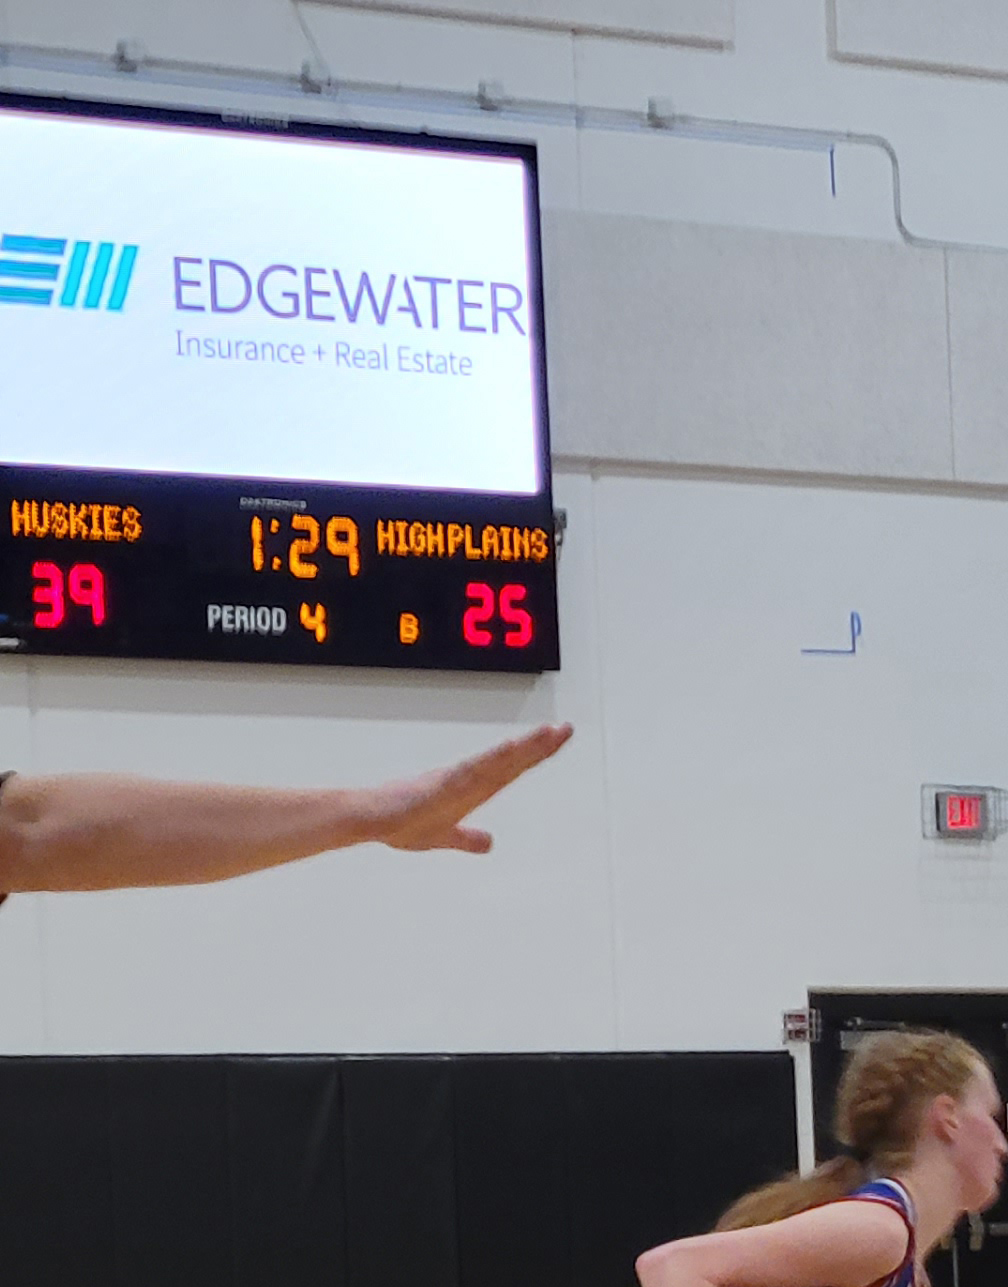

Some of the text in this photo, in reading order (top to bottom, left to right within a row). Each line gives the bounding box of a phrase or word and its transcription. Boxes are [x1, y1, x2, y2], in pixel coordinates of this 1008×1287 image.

[172, 255, 527, 337] EDGEWATER
[175, 329, 305, 364] Insurance
[335, 341, 390, 371] Real
[397, 346, 474, 377] Estate
[10, 499, 143, 543] HUSKIES
[250, 514, 361, 579] 1:29
[376, 519, 550, 562] HIGHPLAINS
[31, 561, 106, 630] 39
[207, 602, 328, 644] PERIOD 4
[461, 581, 534, 648] 25
